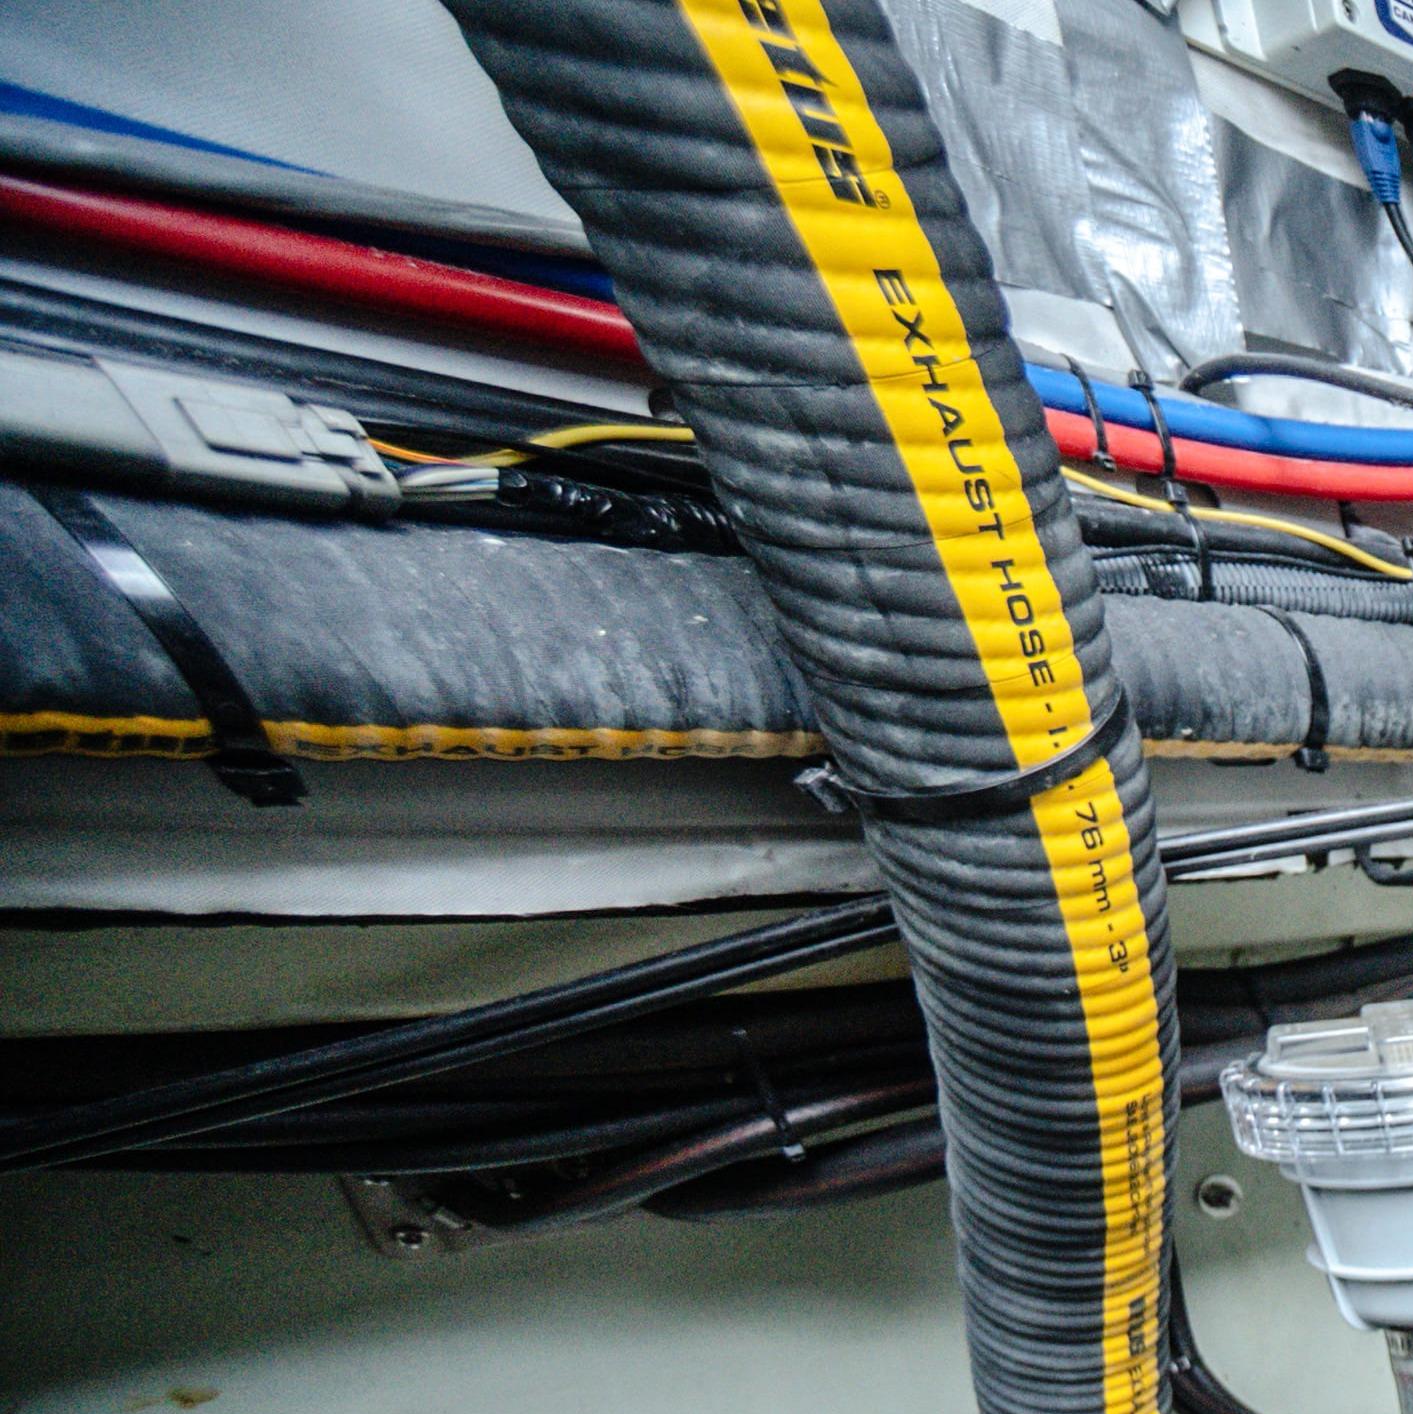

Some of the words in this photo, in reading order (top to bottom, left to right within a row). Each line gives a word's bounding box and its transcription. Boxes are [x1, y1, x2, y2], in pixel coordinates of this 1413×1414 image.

[872, 269, 1005, 541] EXHAUST
[990, 558, 1055, 687] HOSE
[1071, 801, 1106, 850] 76
[1087, 857, 1114, 913] mm
